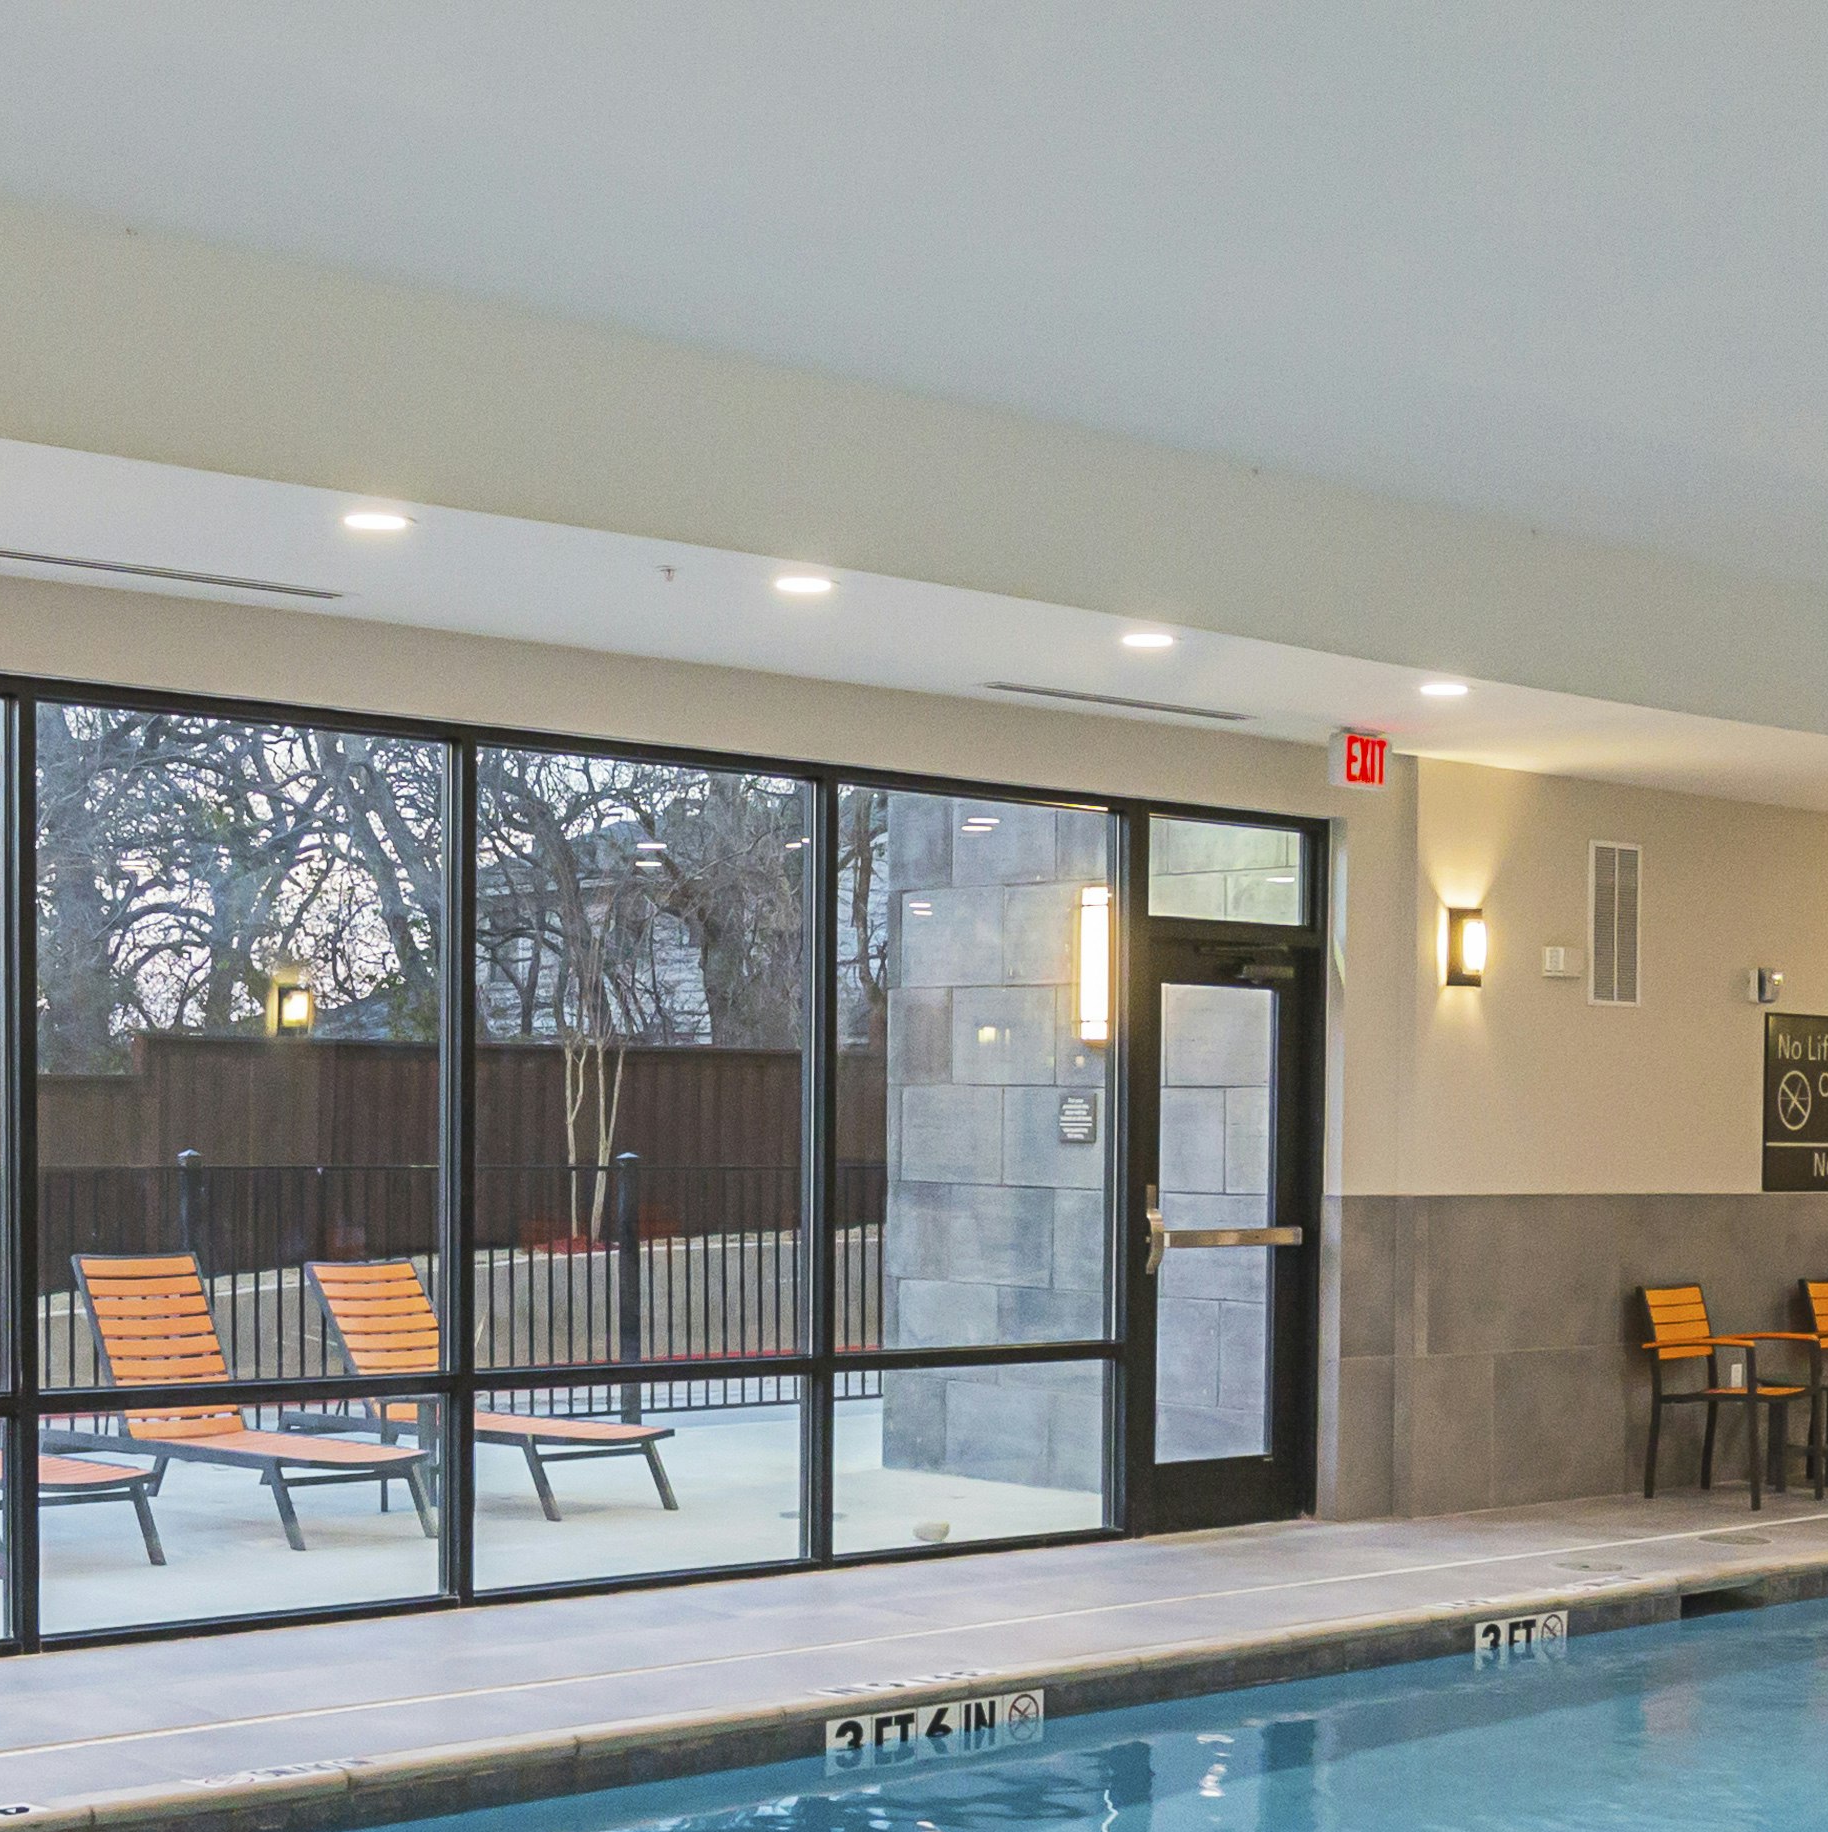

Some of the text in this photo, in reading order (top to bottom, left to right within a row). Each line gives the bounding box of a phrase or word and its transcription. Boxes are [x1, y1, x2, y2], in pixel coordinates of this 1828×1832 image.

[1346, 735, 1387, 784] EXIT
[1777, 1034, 1802, 1060] No
[1508, 1619, 1536, 1648] FT
[926, 1707, 952, 1737] 6
[964, 1700, 996, 1732] IN
